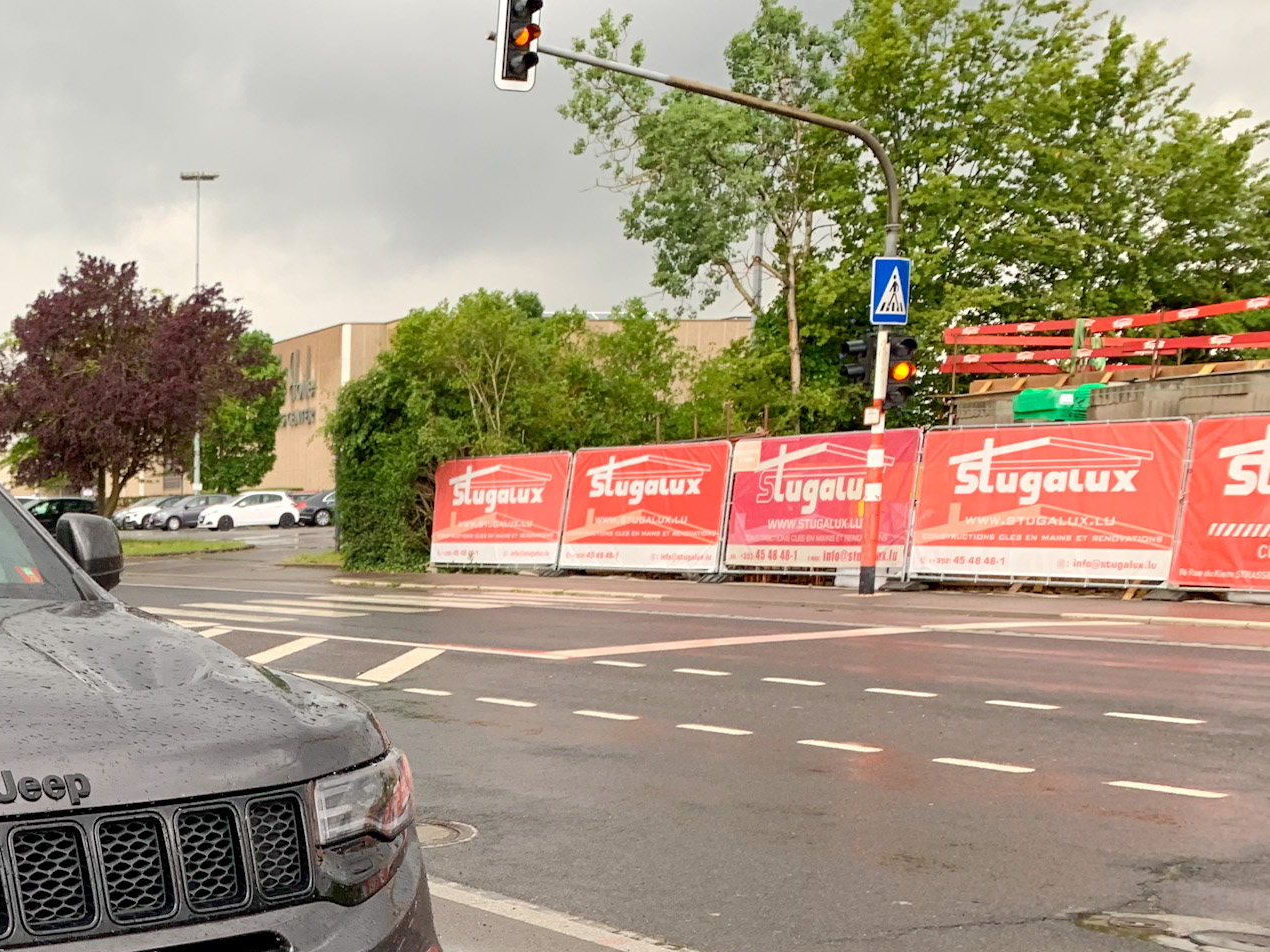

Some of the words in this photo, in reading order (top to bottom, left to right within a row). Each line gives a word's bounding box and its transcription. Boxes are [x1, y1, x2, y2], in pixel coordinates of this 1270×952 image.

[954, 438, 1140, 506] Stugalux
[756, 444, 865, 514] Stugalu
[767, 518, 863, 529] WWW.STUGALUX.LU
[965, 516, 1116, 526] WWW.STUGALUX.LU
[998, 533, 1022, 541] CLES
[1041, 534, 1072, 542] MAINS
[1092, 535, 1163, 544] RENOVATIONS
[756, 549, 766, 561] 45
[768, 549, 778, 561] 48
[780, 549, 798, 561] 48-1
[953, 556, 965, 565] 45
[968, 556, 981, 566] 48
[983, 556, 1005, 566] 48-1
[1073, 559, 1158, 571] info@stugalux.lu
